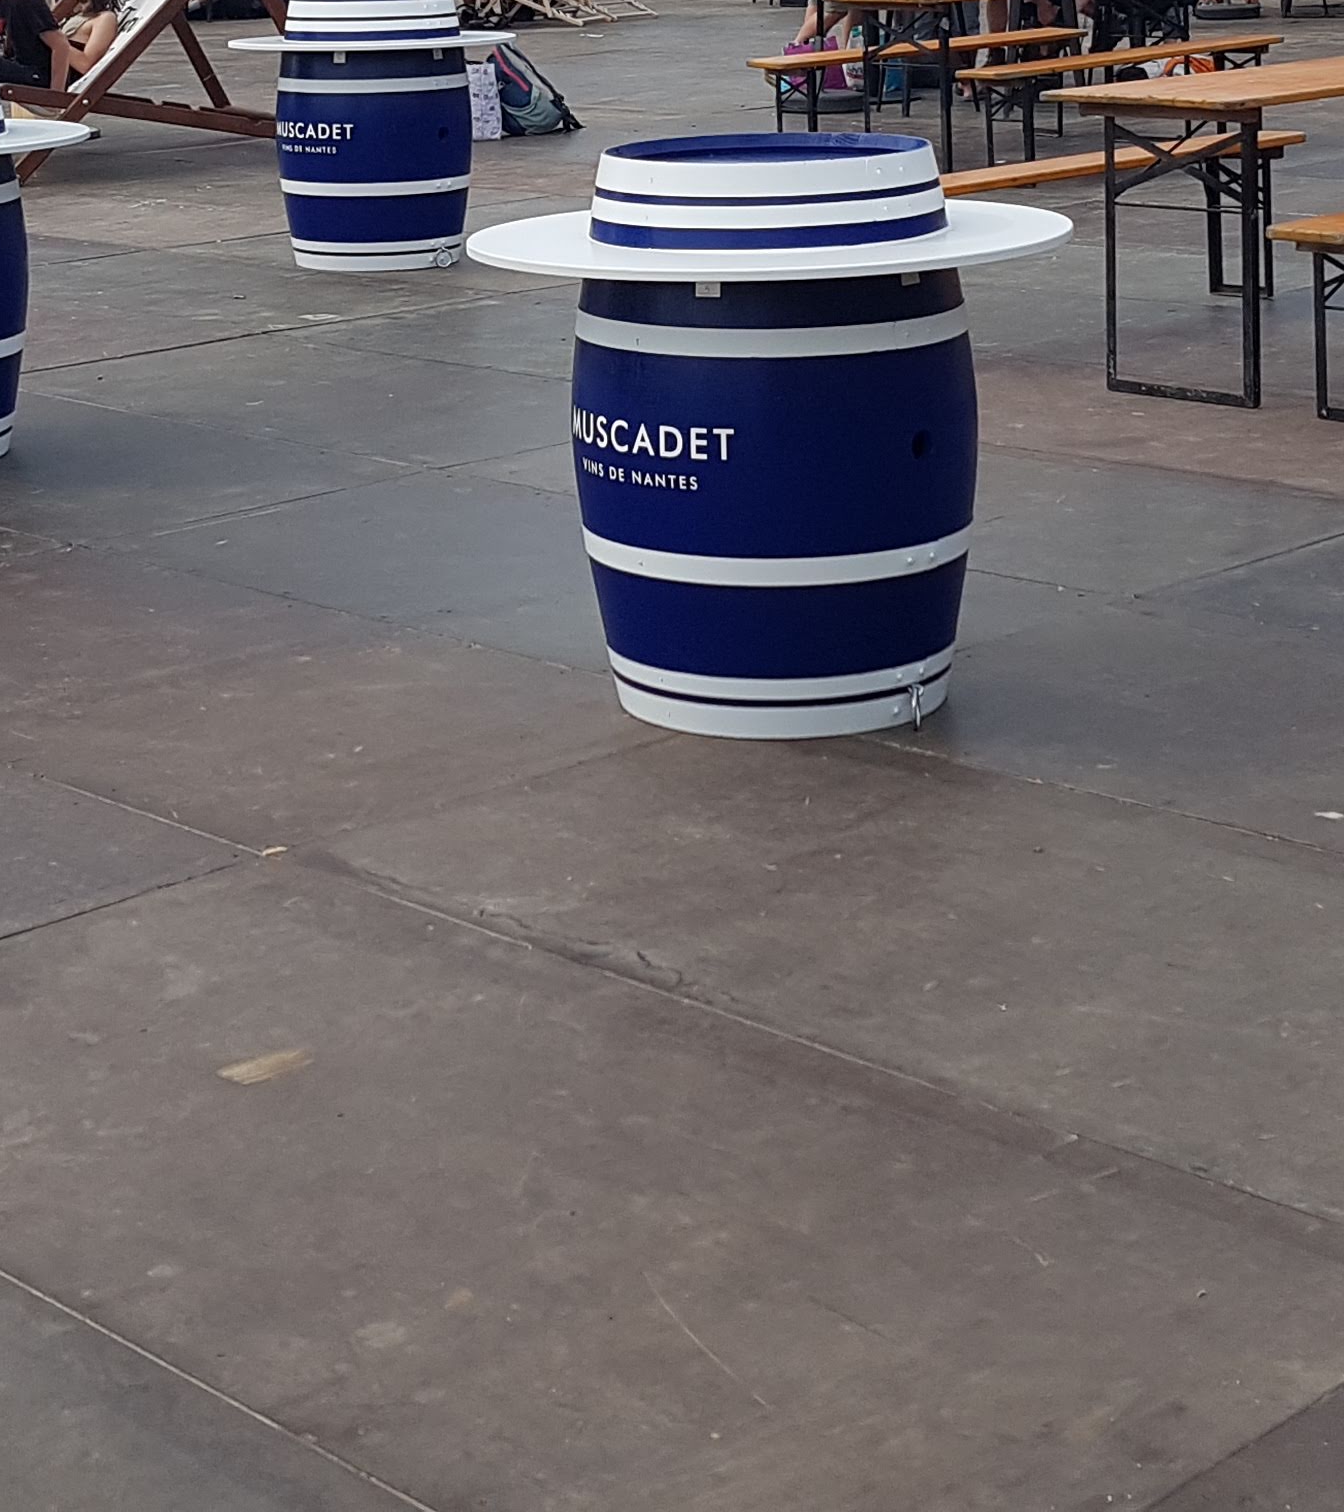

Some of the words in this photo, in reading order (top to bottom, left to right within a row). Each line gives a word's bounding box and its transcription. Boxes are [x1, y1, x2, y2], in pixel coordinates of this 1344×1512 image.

[277, 121, 354, 140] MUSCADET
[573, 404, 735, 461] MUSCADET
[583, 457, 604, 478] VINS
[609, 466, 625, 482] DE
[632, 470, 698, 491] NANTES
